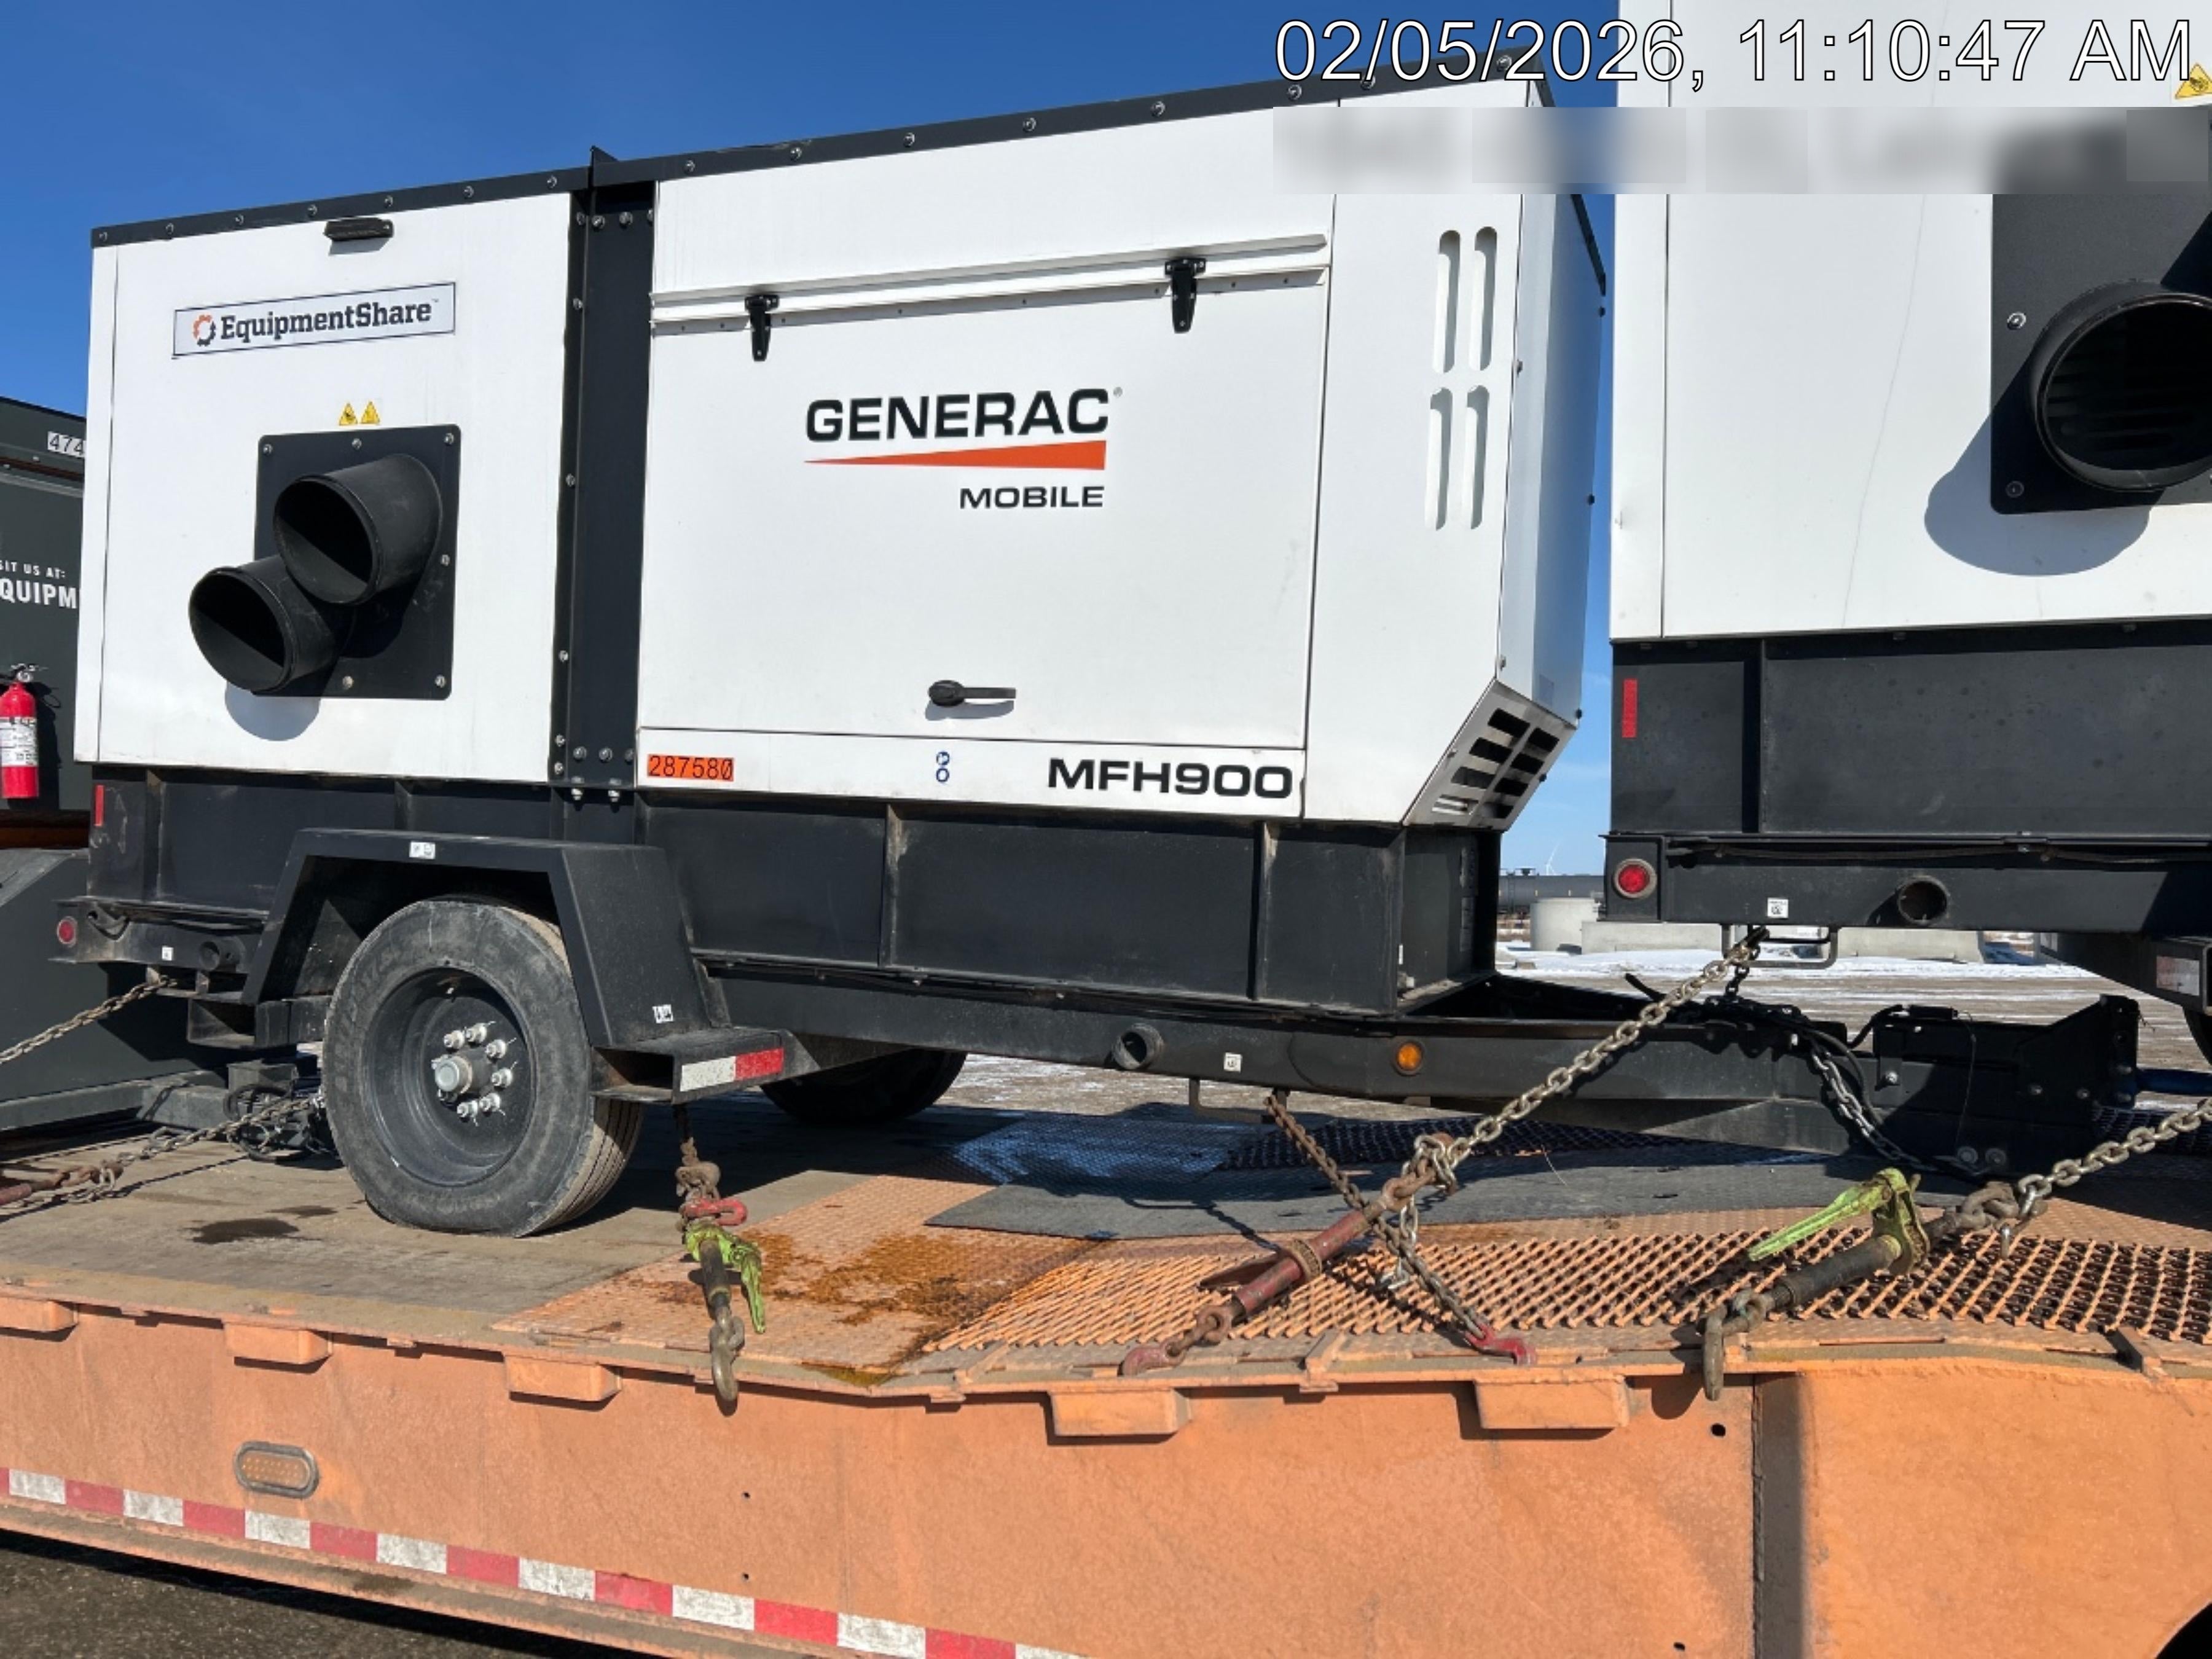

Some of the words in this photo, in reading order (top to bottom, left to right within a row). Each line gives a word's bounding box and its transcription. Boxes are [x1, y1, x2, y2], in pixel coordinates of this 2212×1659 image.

[220, 302, 432, 343] EquipmentShare
[807, 388, 1108, 442] GENERAC
[960, 486, 1104, 509] MOBILE
[23, 563, 40, 576] US
[649, 755, 734, 781] 287580
[1048, 758, 1292, 799] MFH900
